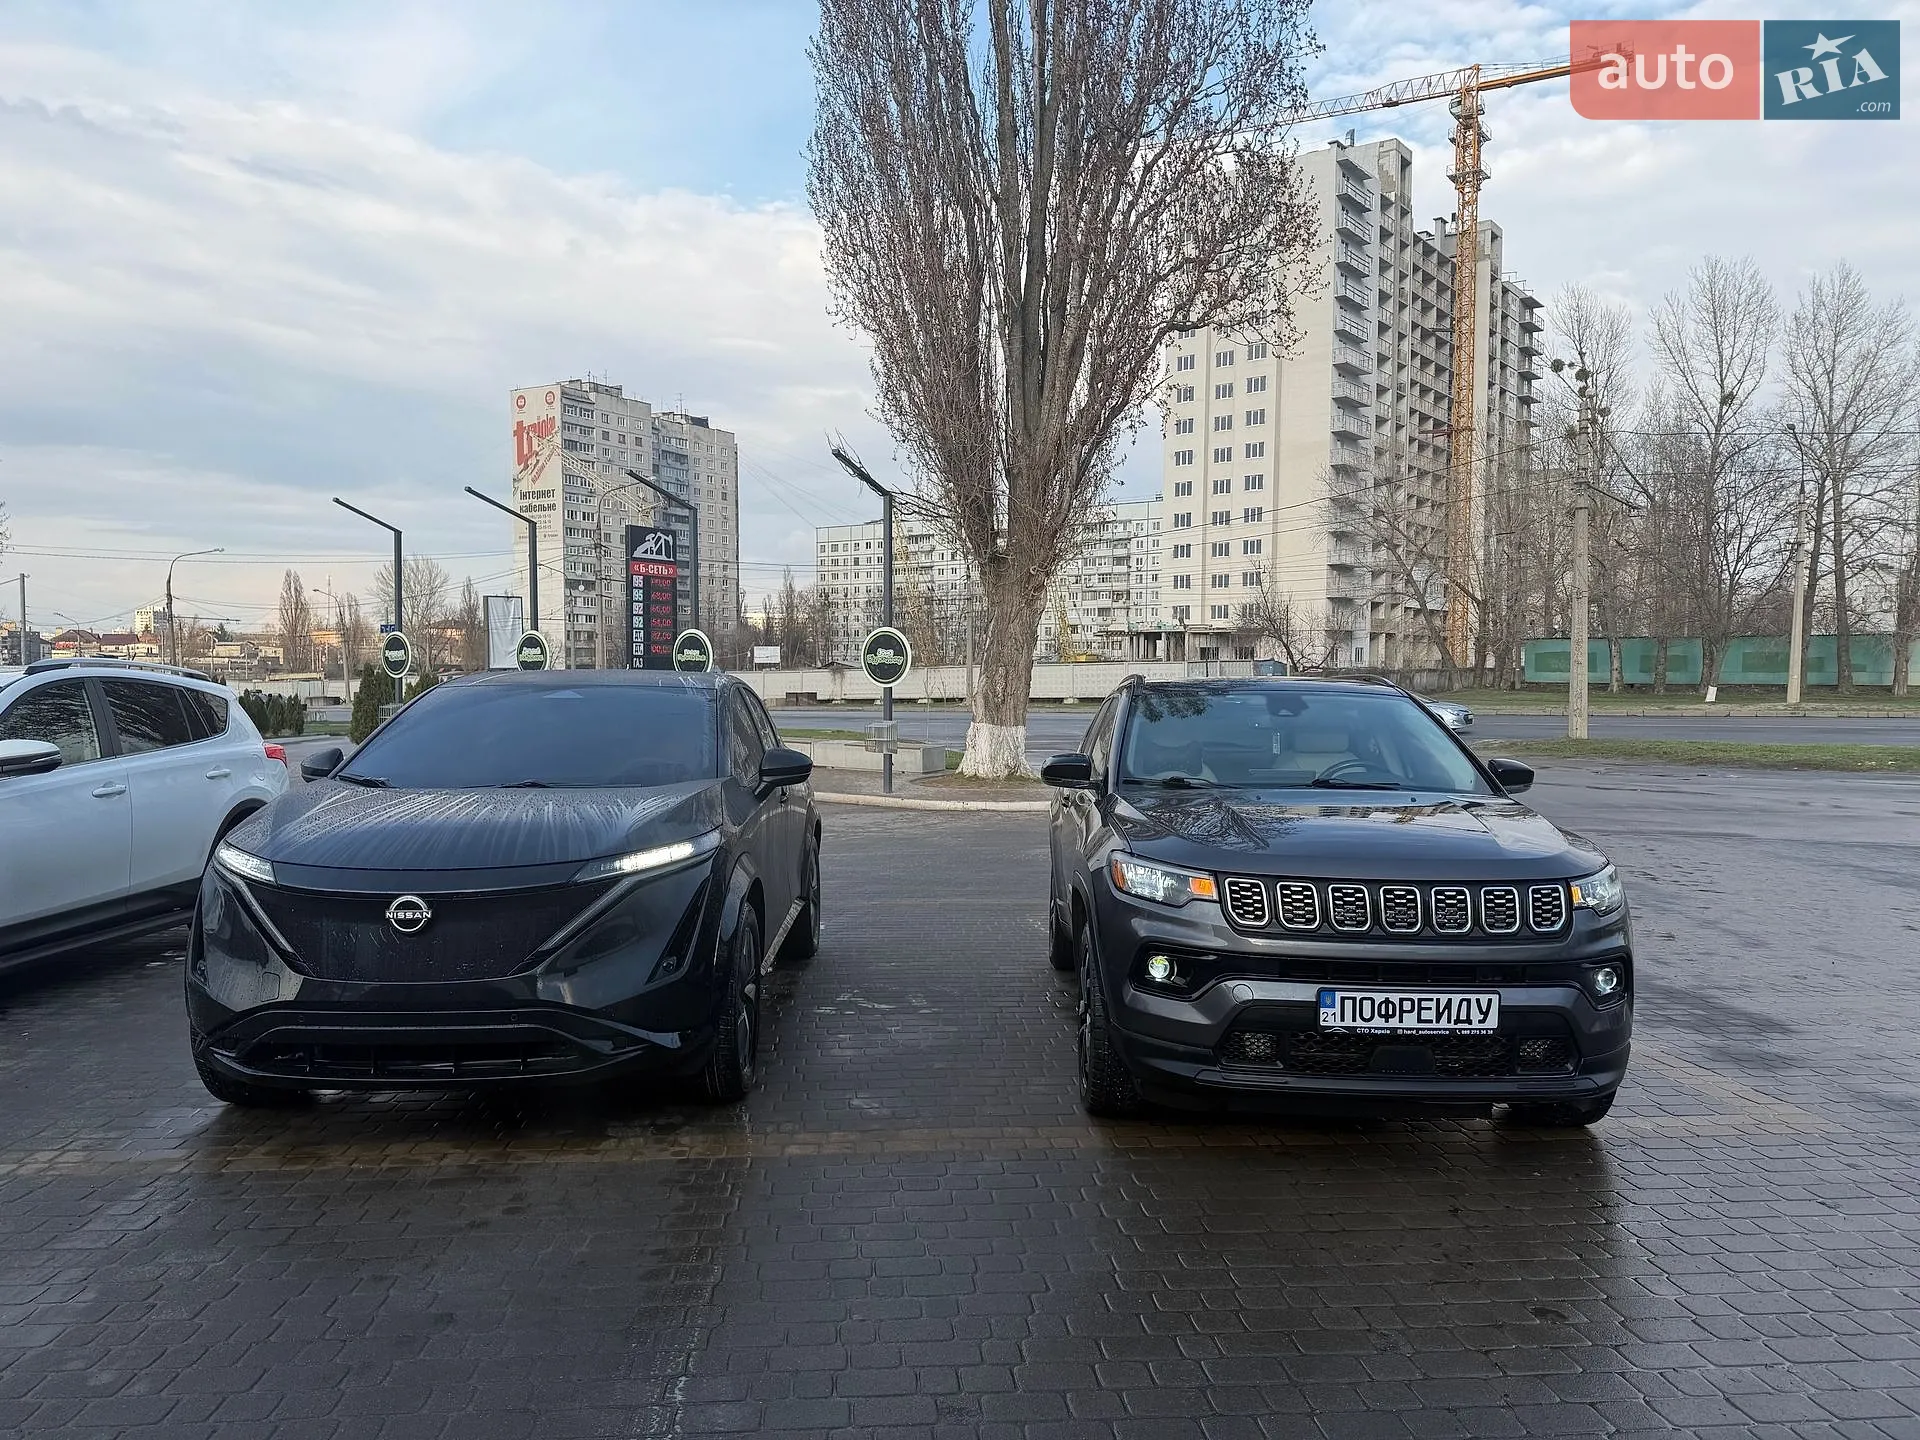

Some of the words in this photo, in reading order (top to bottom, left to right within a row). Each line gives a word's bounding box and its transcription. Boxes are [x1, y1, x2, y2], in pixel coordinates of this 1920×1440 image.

[519, 502, 557, 513] кабельне
[386, 911, 431, 919] NISSAN
[1322, 1012, 1336, 1023] 21
[1339, 996, 1493, 1025] ПОФРЕИДУ
